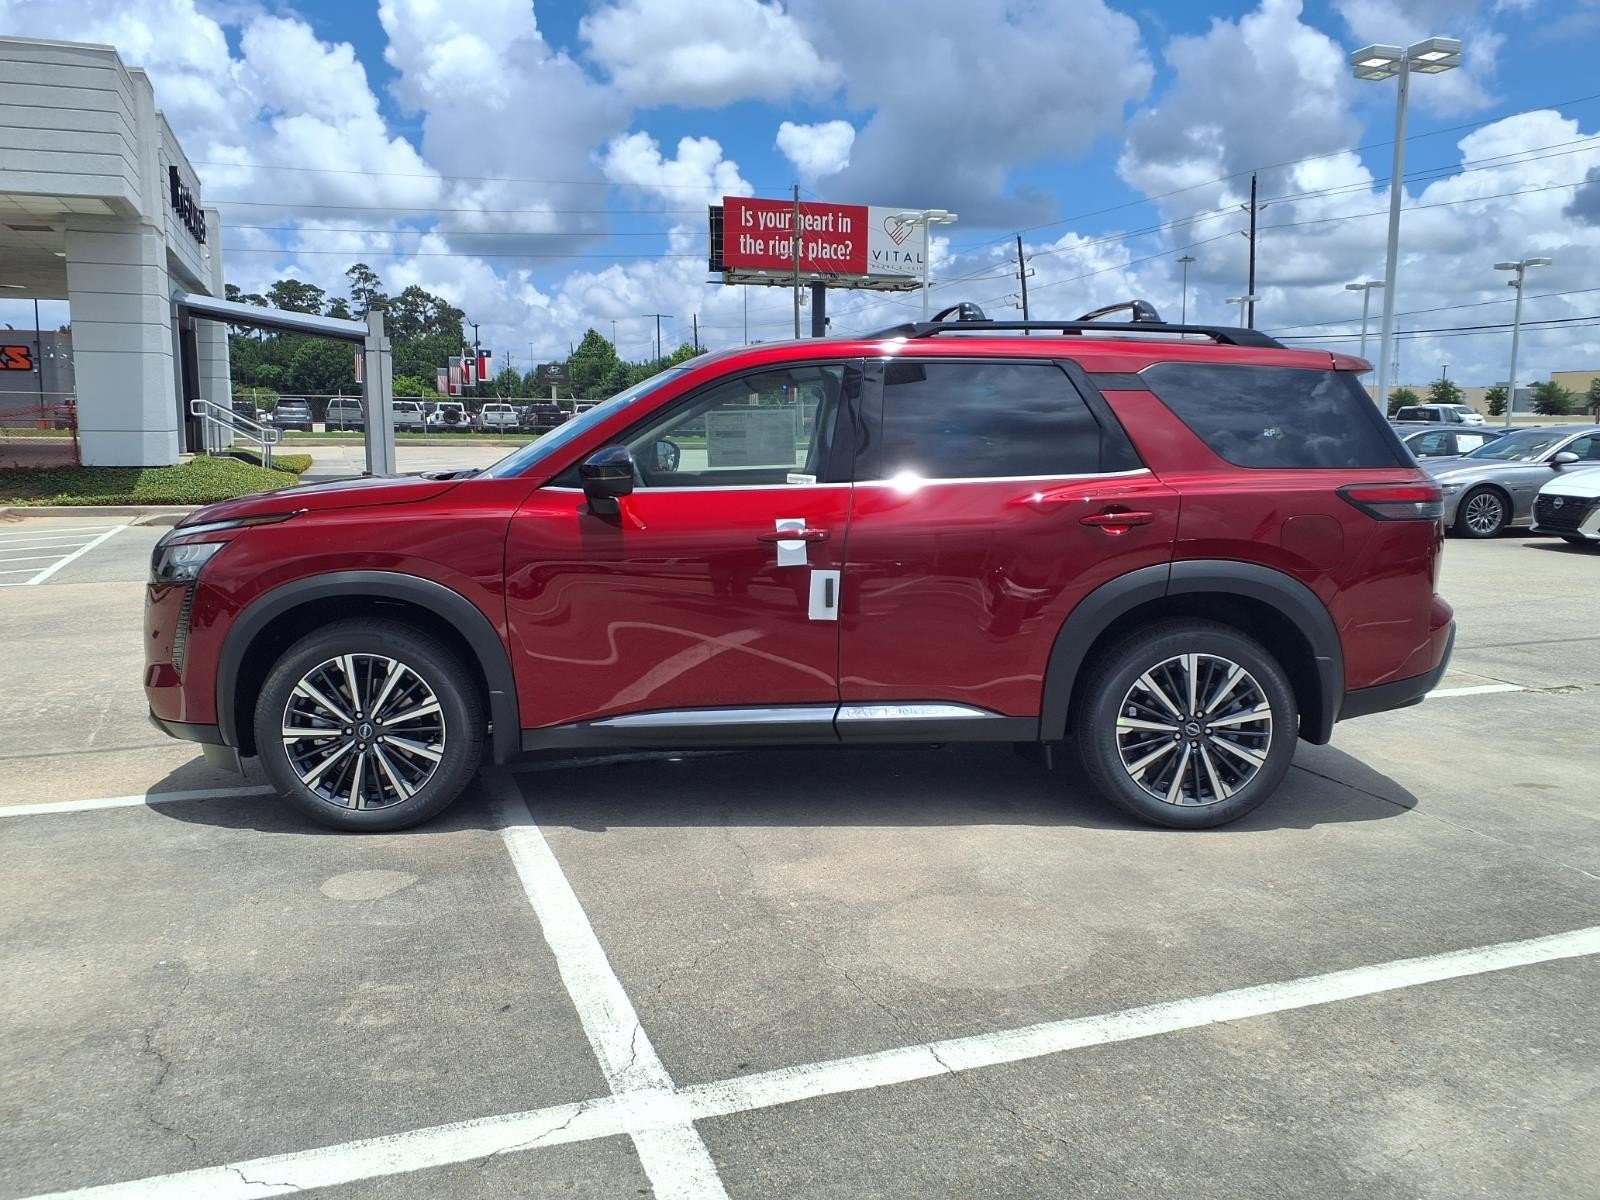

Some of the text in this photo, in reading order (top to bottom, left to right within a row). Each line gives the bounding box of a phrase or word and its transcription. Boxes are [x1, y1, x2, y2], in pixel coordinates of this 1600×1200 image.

[741, 205, 754, 227] Is
[758, 210, 792, 231] your
[838, 212, 851, 233] in
[740, 233, 764, 255] the
[808, 238, 853, 261] place?
[872, 249, 924, 264] VITAL
